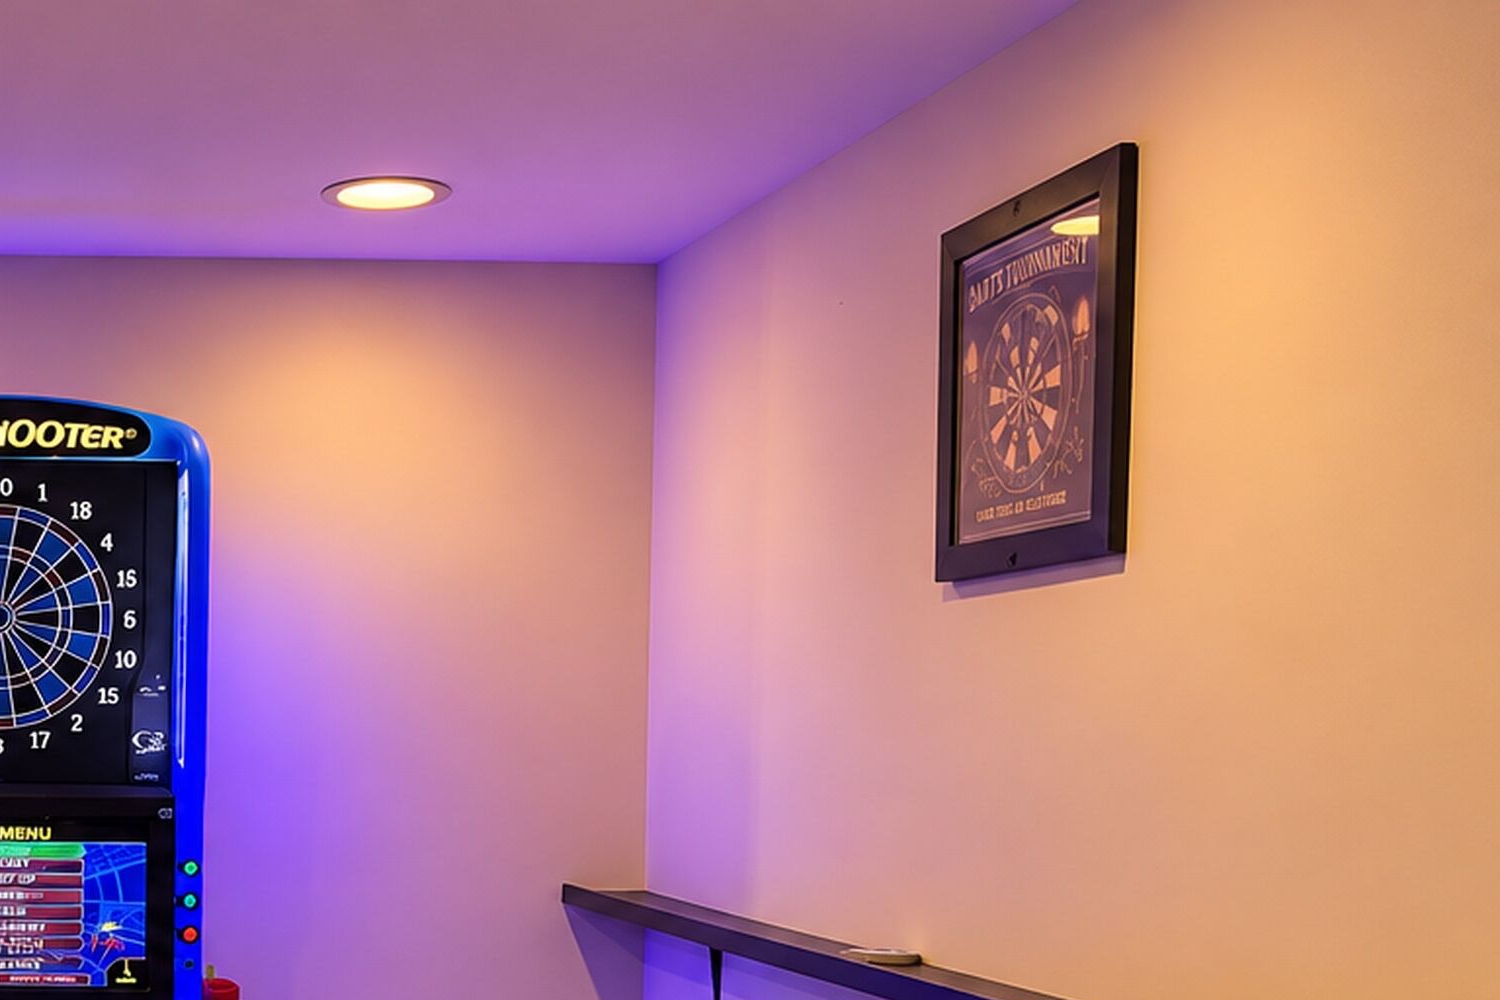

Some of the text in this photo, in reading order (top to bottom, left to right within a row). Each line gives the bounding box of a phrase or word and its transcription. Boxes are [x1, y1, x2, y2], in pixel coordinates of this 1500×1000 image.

[38, 483, 48, 502] 1
[70, 501, 93, 520] 18
[100, 532, 114, 552] 4
[123, 609, 137, 630] 6
[114, 649, 137, 668] 10
[97, 686, 120, 705] 15
[70, 713, 83, 732] 2
[29, 730, 51, 749] 17
[0, 825, 53, 841] MENU
